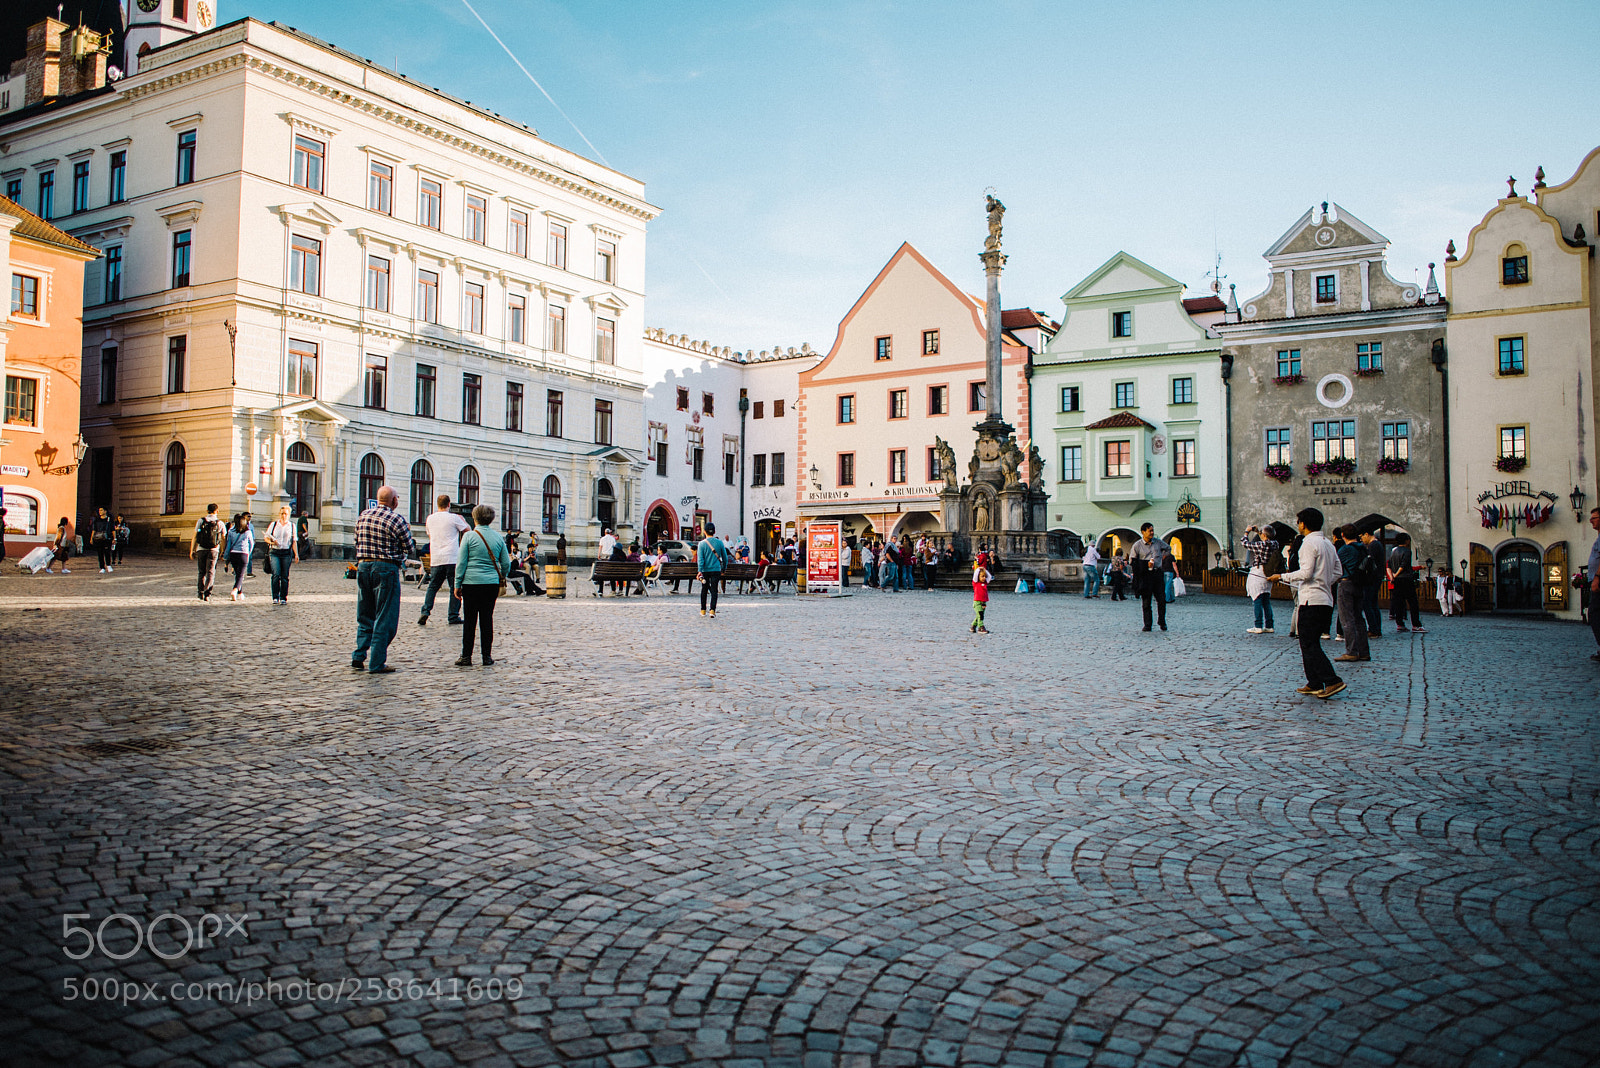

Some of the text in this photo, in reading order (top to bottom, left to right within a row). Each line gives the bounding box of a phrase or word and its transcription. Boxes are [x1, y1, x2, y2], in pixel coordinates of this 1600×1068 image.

[2, 466, 26, 474] MADETA
[1495, 480, 1536, 498] HOTEL
[809, 491, 842, 500] RESTAURANT
[753, 506, 781, 519] PASÁŽ
